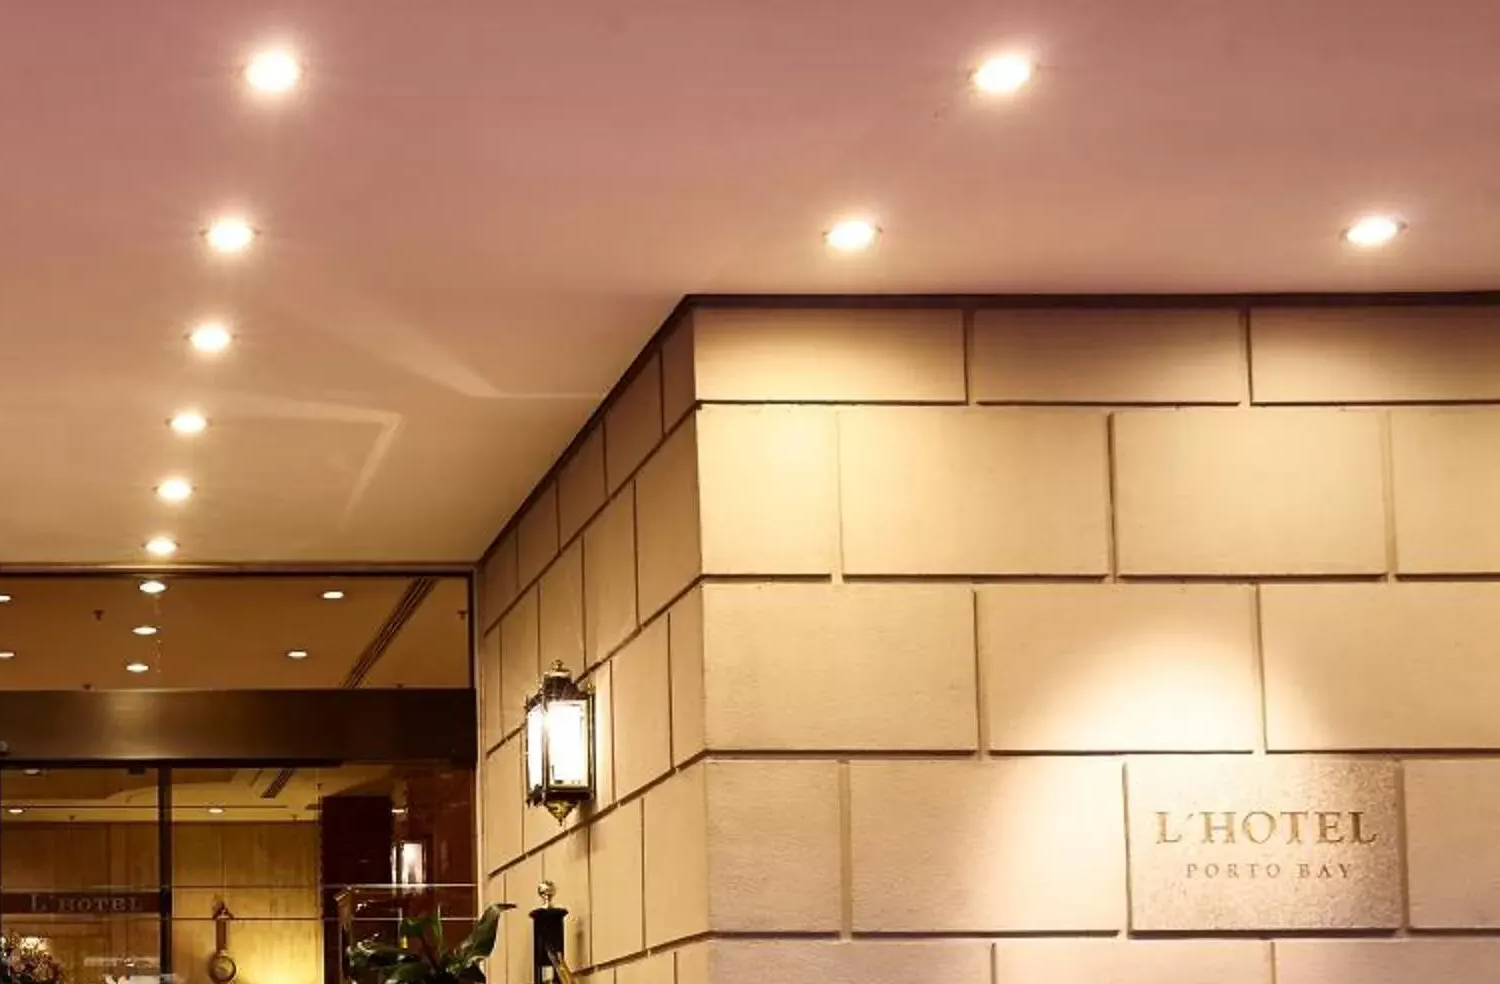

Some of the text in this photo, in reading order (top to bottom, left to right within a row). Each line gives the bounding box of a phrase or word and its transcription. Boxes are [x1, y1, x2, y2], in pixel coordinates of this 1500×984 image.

[1155, 811, 1378, 845] L'HOTEL
[1186, 863, 1353, 879] PORTO BAY
